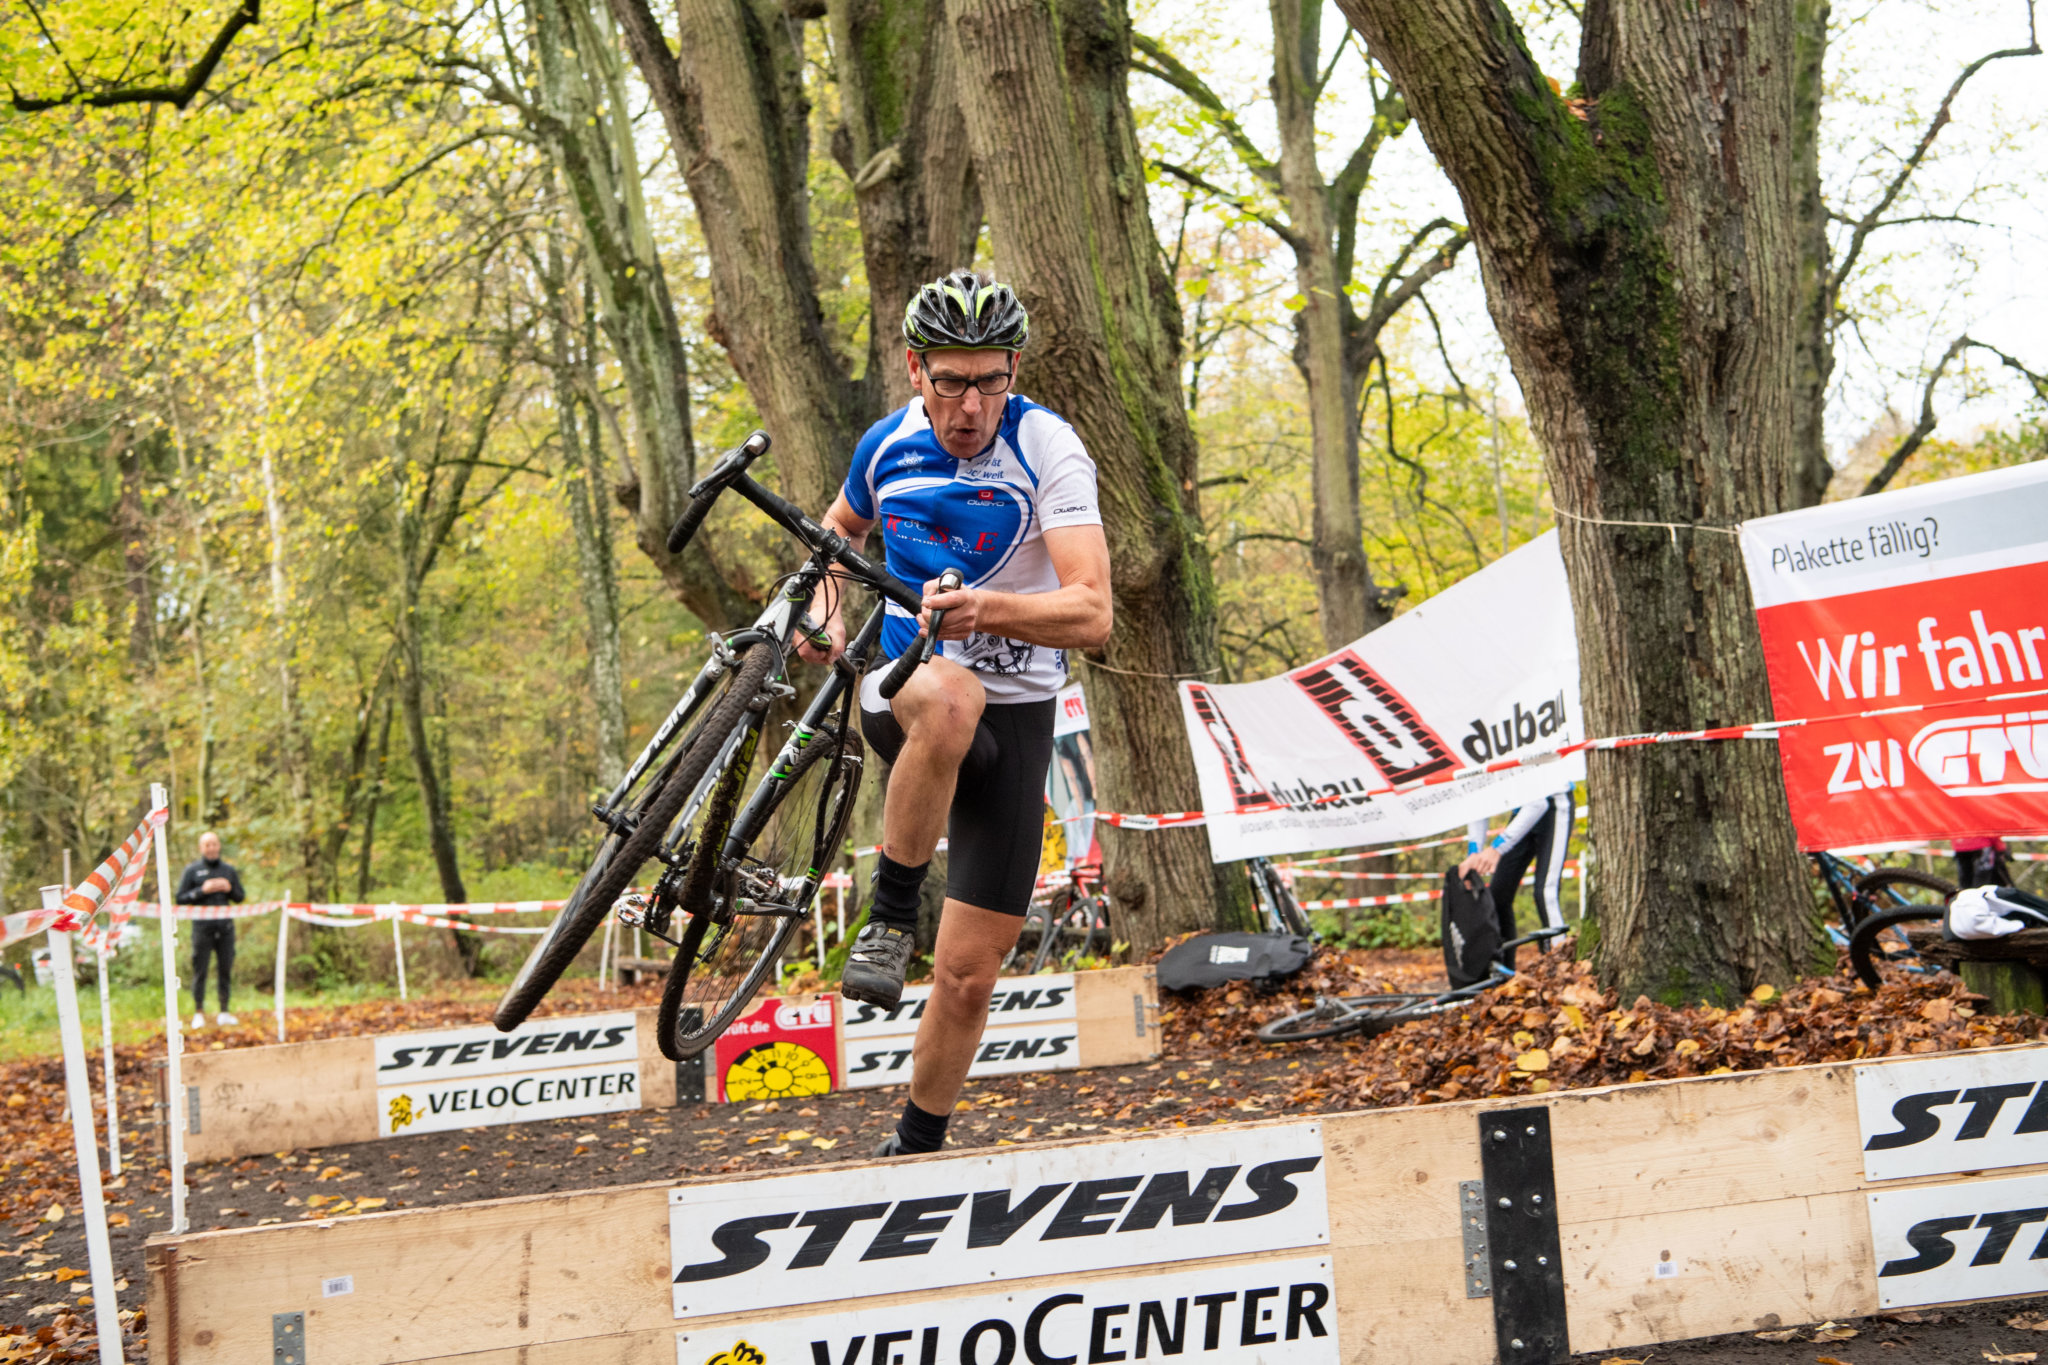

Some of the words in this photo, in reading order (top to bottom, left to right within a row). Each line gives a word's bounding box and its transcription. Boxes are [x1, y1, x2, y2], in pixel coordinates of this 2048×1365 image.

[1771, 536, 1865, 575] Plakette
[1868, 516, 1940, 559] fällig?
[1796, 631, 1909, 701] Wir
[378, 1025, 635, 1072] STEVENS
[750, 1021, 770, 1034] die
[672, 1155, 1323, 1284] STEVENS
